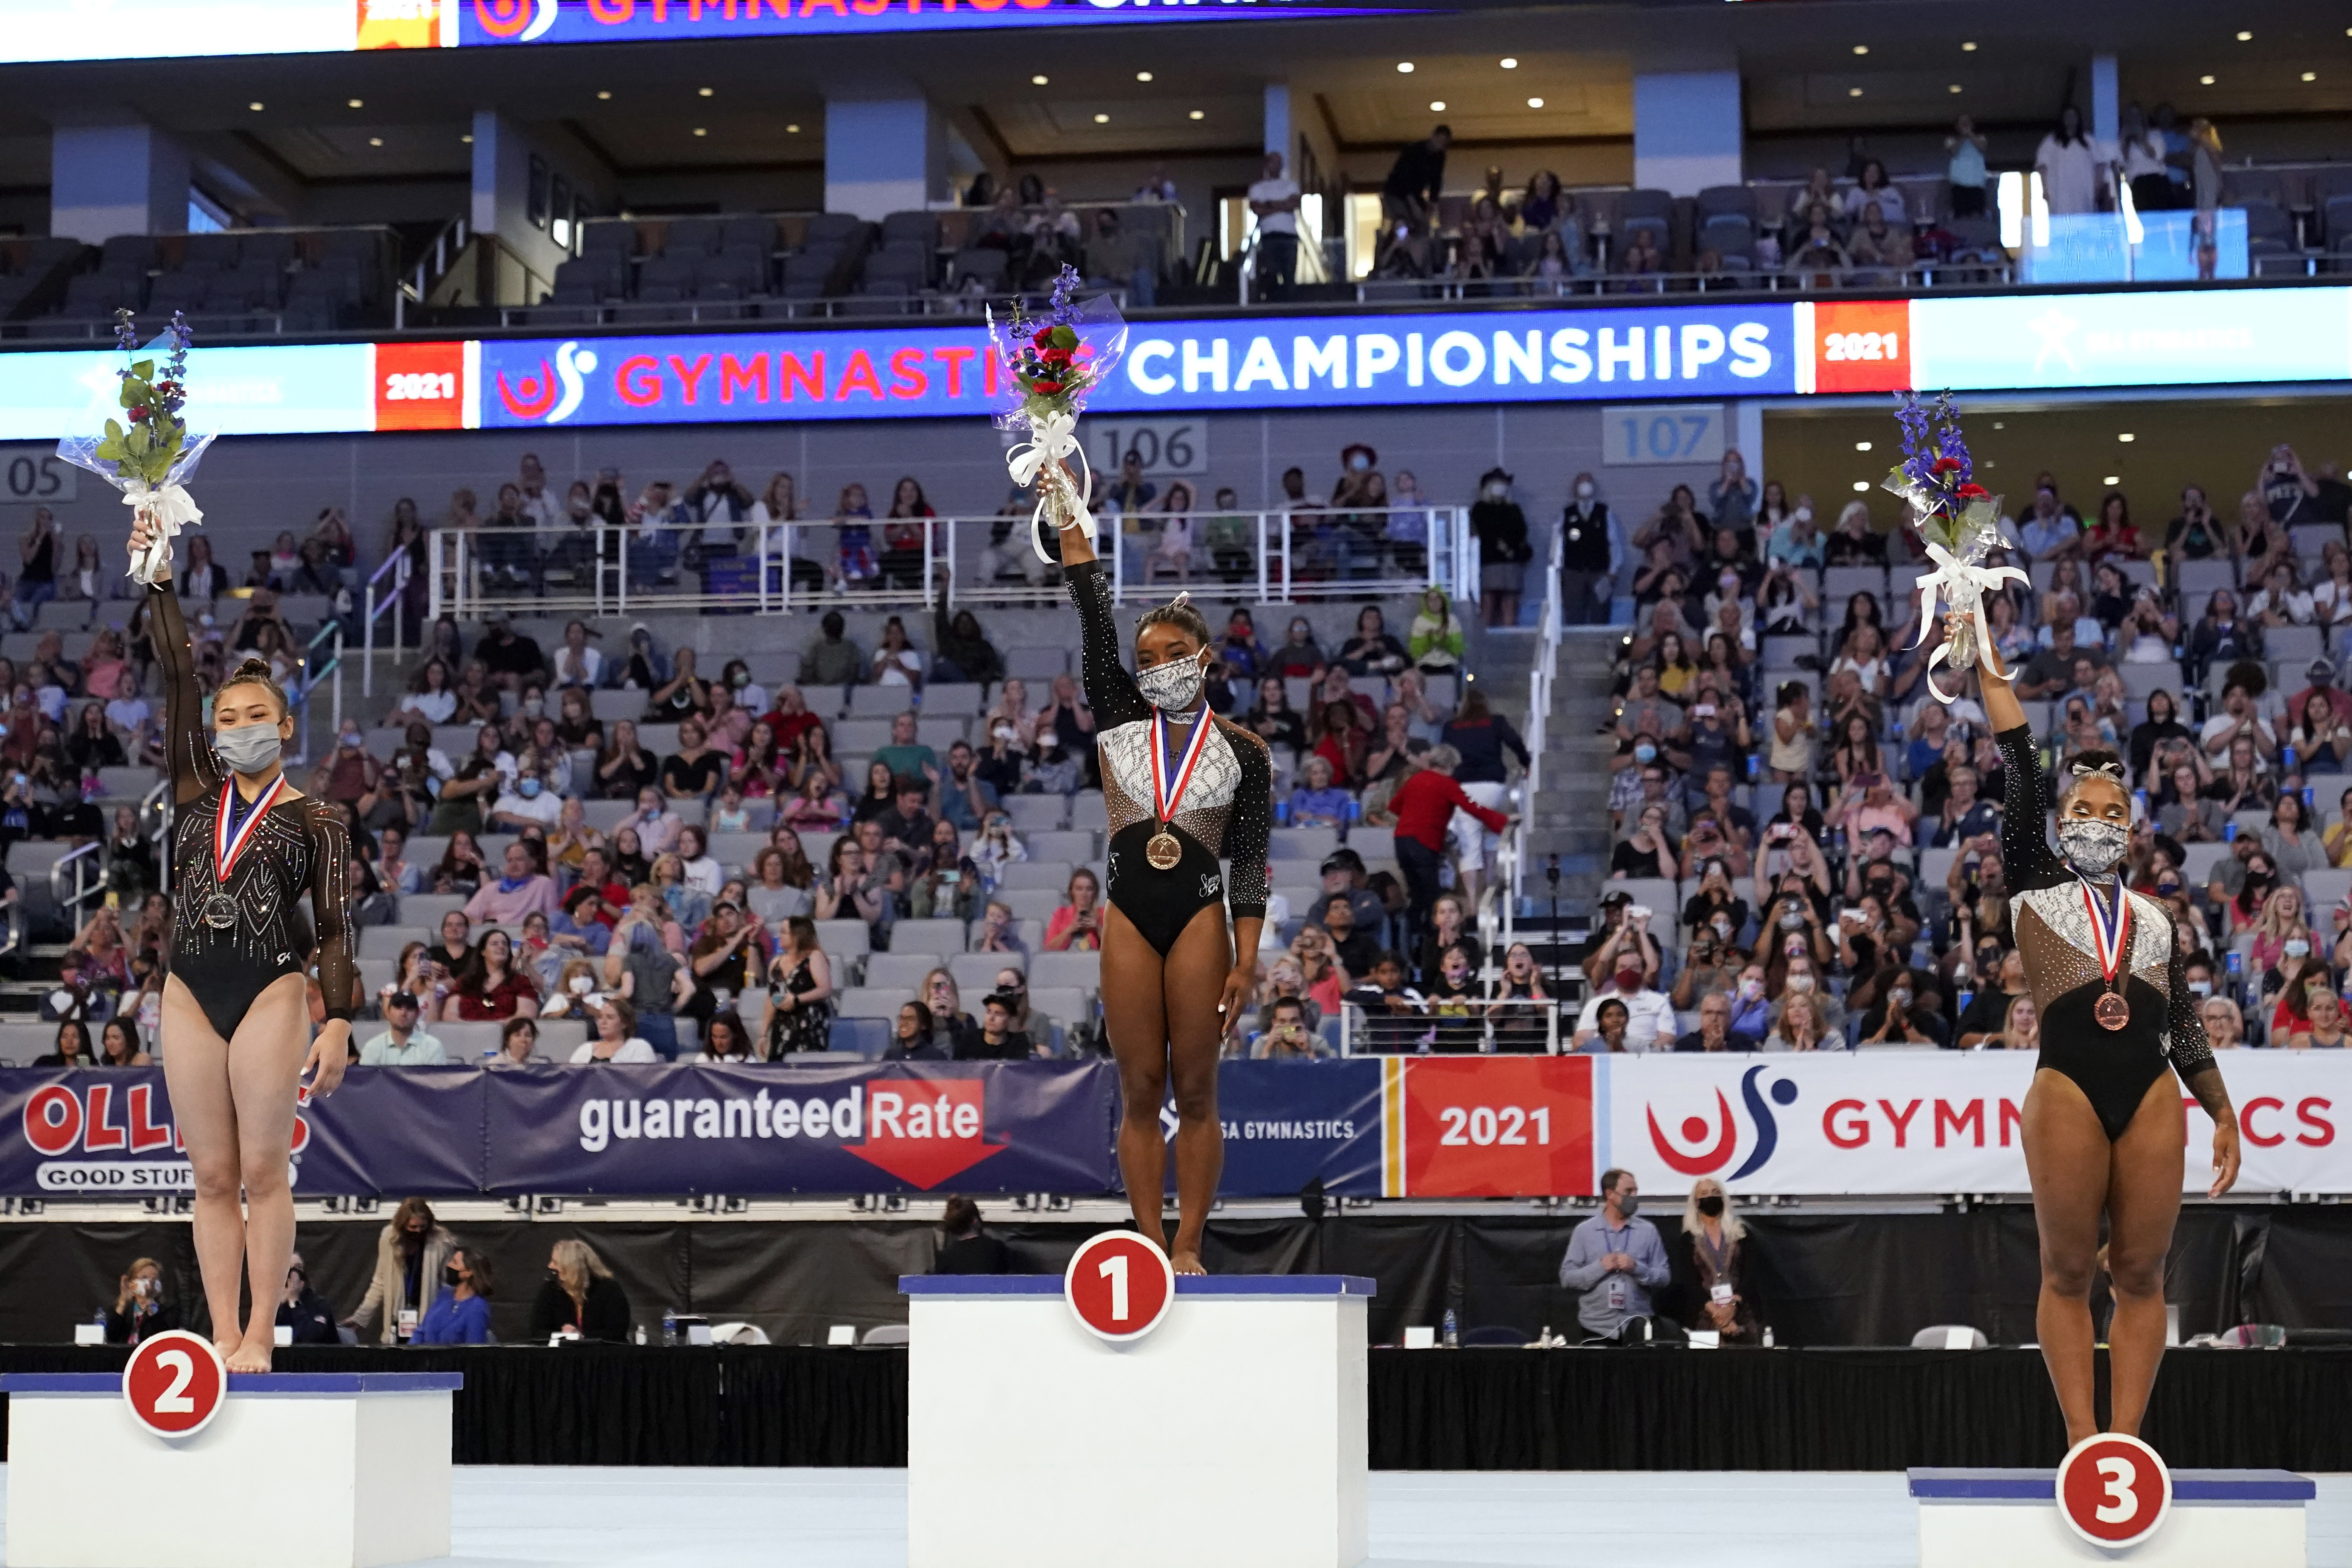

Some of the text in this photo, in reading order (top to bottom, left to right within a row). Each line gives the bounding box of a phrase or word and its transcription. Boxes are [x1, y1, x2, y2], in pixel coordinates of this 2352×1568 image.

[1127, 321, 1772, 395] CHAMPIONSHIPS
[1824, 332, 1899, 361] 2021
[386, 372, 455, 400] 2021
[1104, 427, 1194, 469] 106
[1623, 415, 1711, 458] 107
[579, 1086, 979, 1152] guaranteed Rate
[1244, 1118, 1354, 1140] GYMNASTICS
[1440, 1105, 1550, 1146] 2021
[1098, 1255, 1128, 1320] 1
[154, 1349, 194, 1413] 2
[2095, 1456, 2138, 1523] 3
